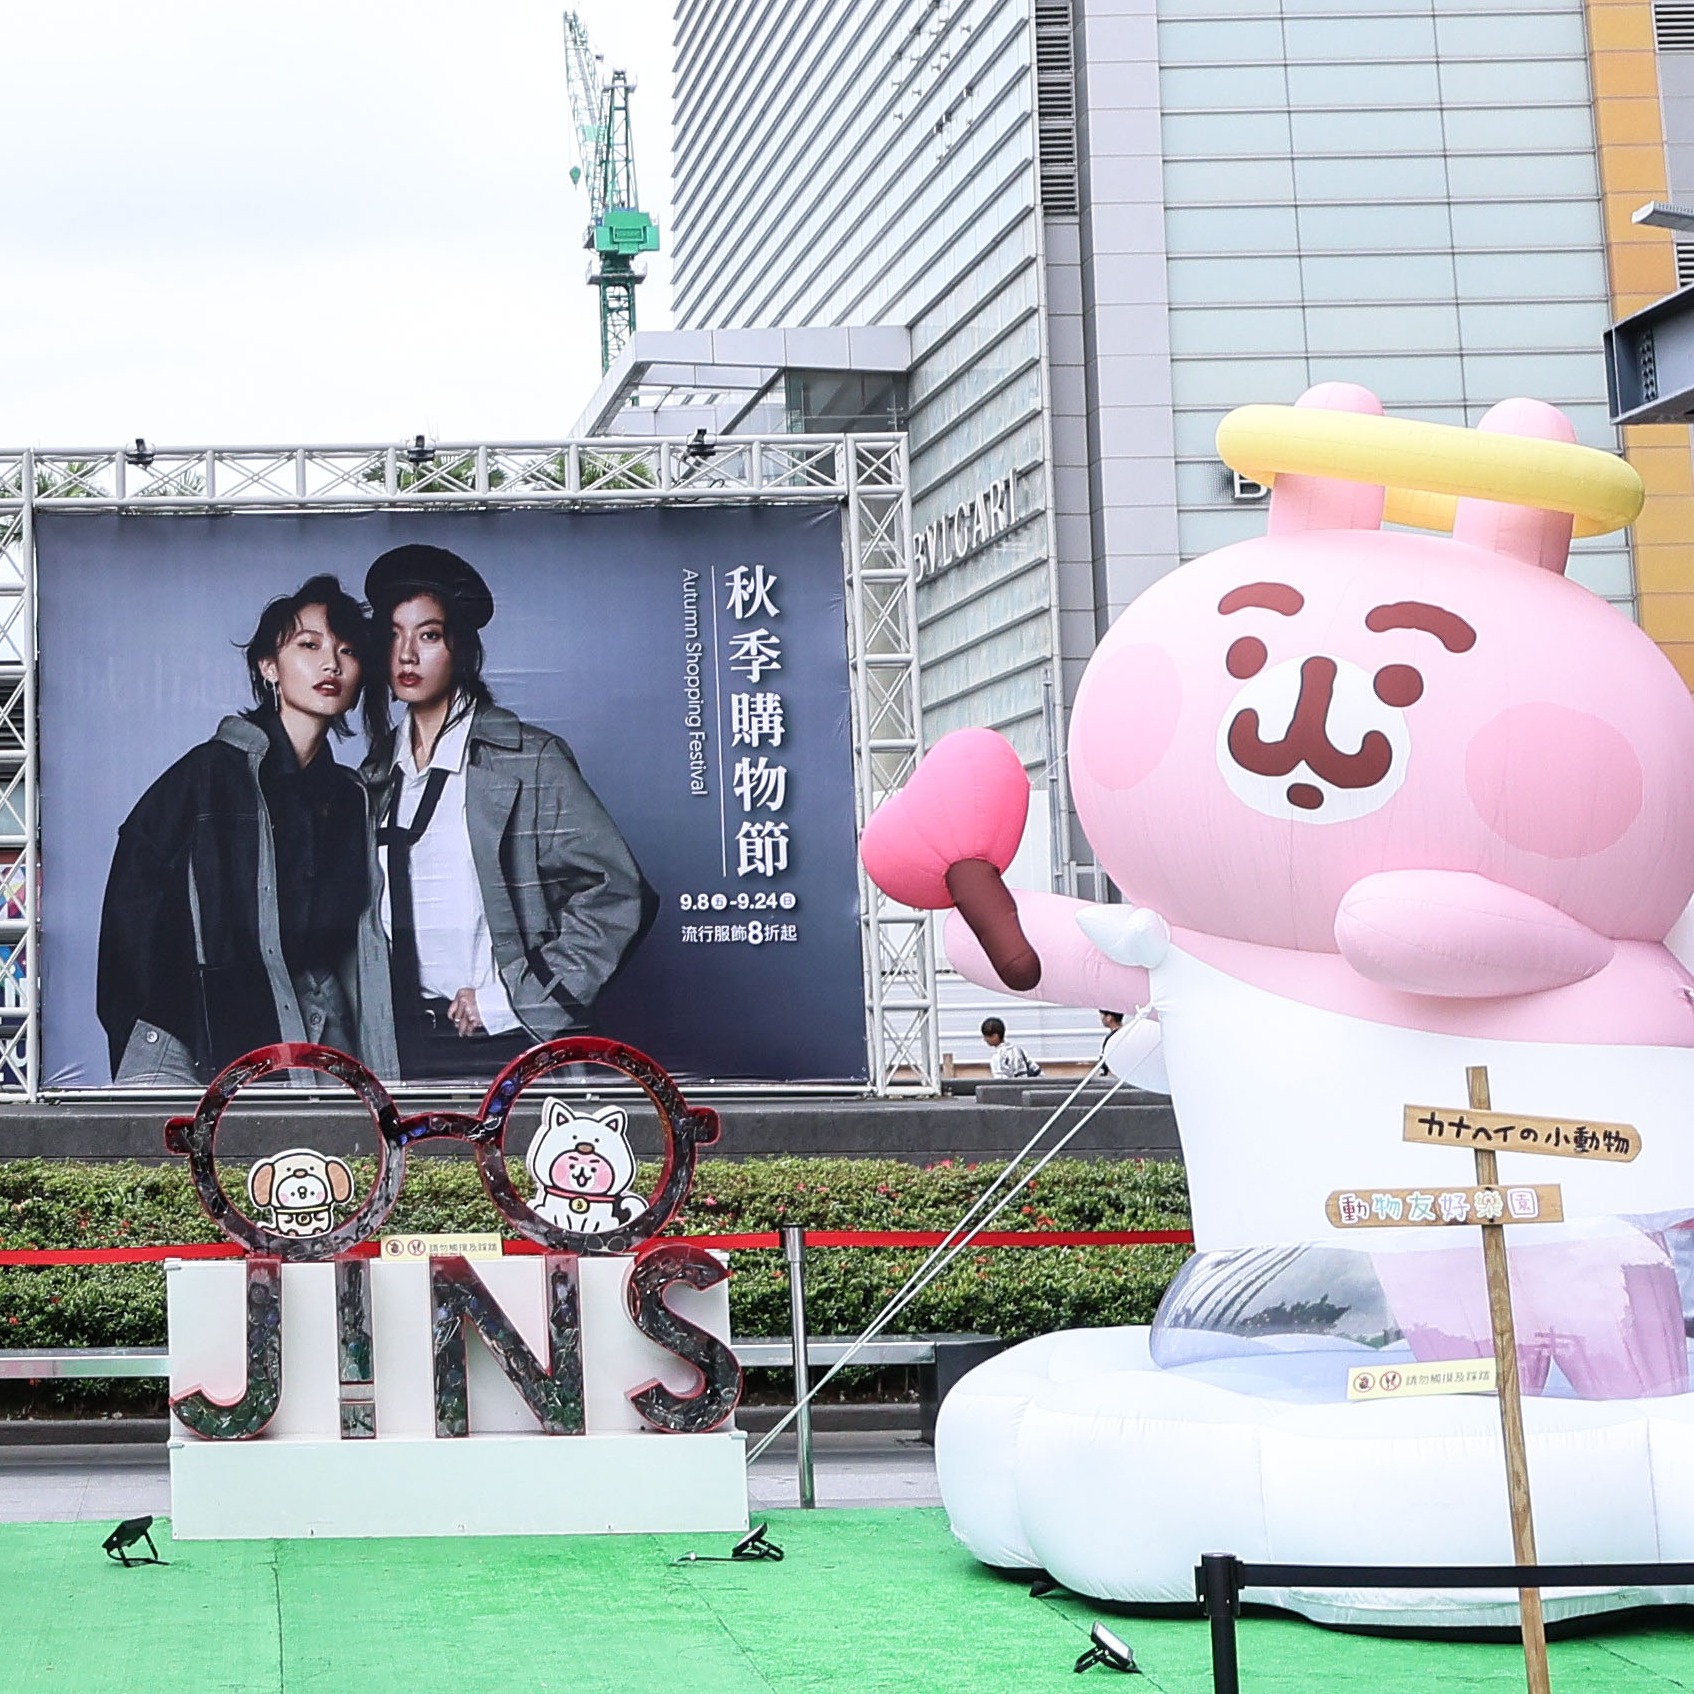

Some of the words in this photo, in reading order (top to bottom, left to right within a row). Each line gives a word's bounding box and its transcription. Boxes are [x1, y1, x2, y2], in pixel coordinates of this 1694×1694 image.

[913, 465, 1019, 583] BVLGARI
[682, 568, 699, 639] Autumn
[684, 642, 703, 730] Shopping
[724, 564, 789, 878] 秋季購物節
[689, 732, 708, 796] Festival
[681, 920, 798, 945] 流行服飾8折起
[1418, 1112, 1630, 1154] カナヘイの小動物
[1339, 1188, 1539, 1223] 動物友好樂園
